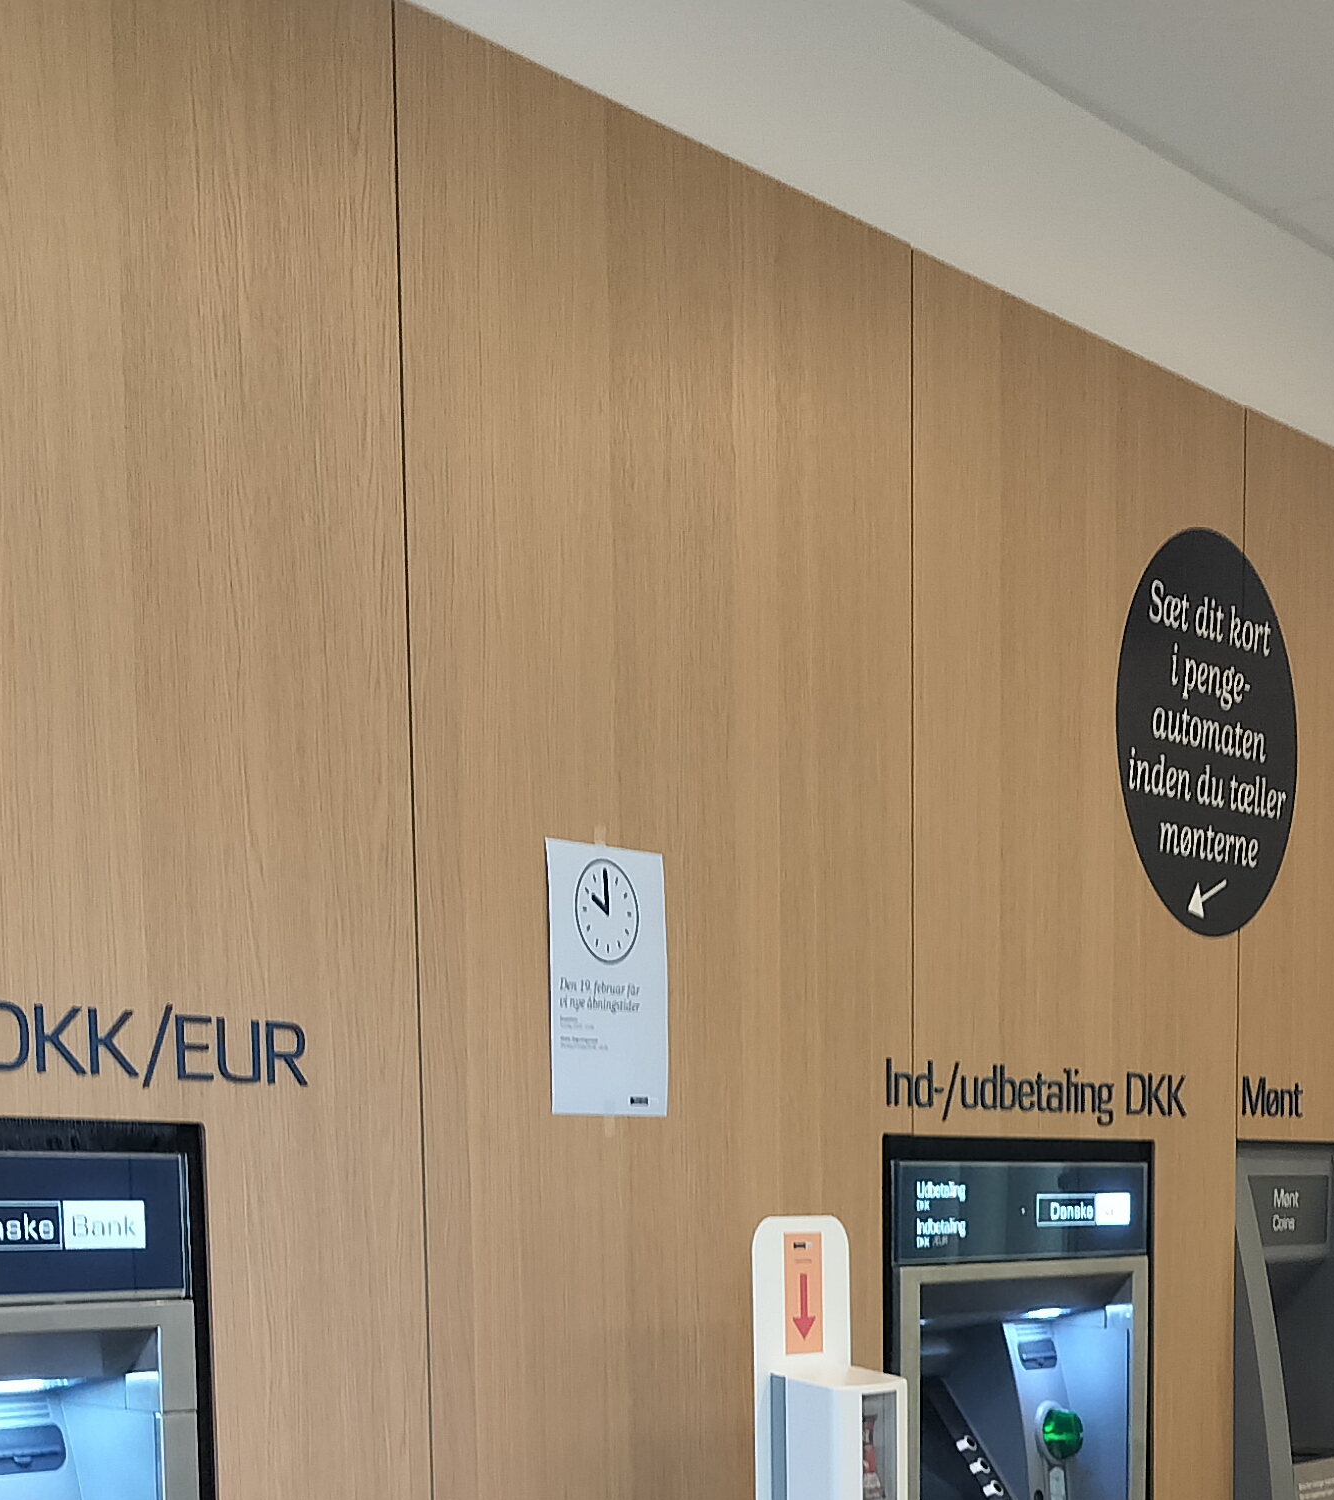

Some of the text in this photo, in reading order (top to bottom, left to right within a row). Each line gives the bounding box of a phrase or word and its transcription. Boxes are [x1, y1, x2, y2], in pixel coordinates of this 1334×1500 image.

[1148, 578, 1272, 657] Sæt dit kort
[1171, 642, 1251, 711] i penge-
[1152, 705, 1267, 763] automaten
[1128, 746, 1287, 821] inden du tæller
[1158, 820, 1259, 869] mønterne
[559, 976, 578, 993] Den
[593, 979, 626, 999] februar
[569, 997, 585, 1013] nye
[884, 1057, 1188, 1126] Ind-/udbetaling DKK
[1241, 1076, 1304, 1118] Mønt
[916, 1181, 966, 1203] Udbetaling
[1050, 1201, 1094, 1221] Danske
[71, 1213, 137, 1238] Bank
